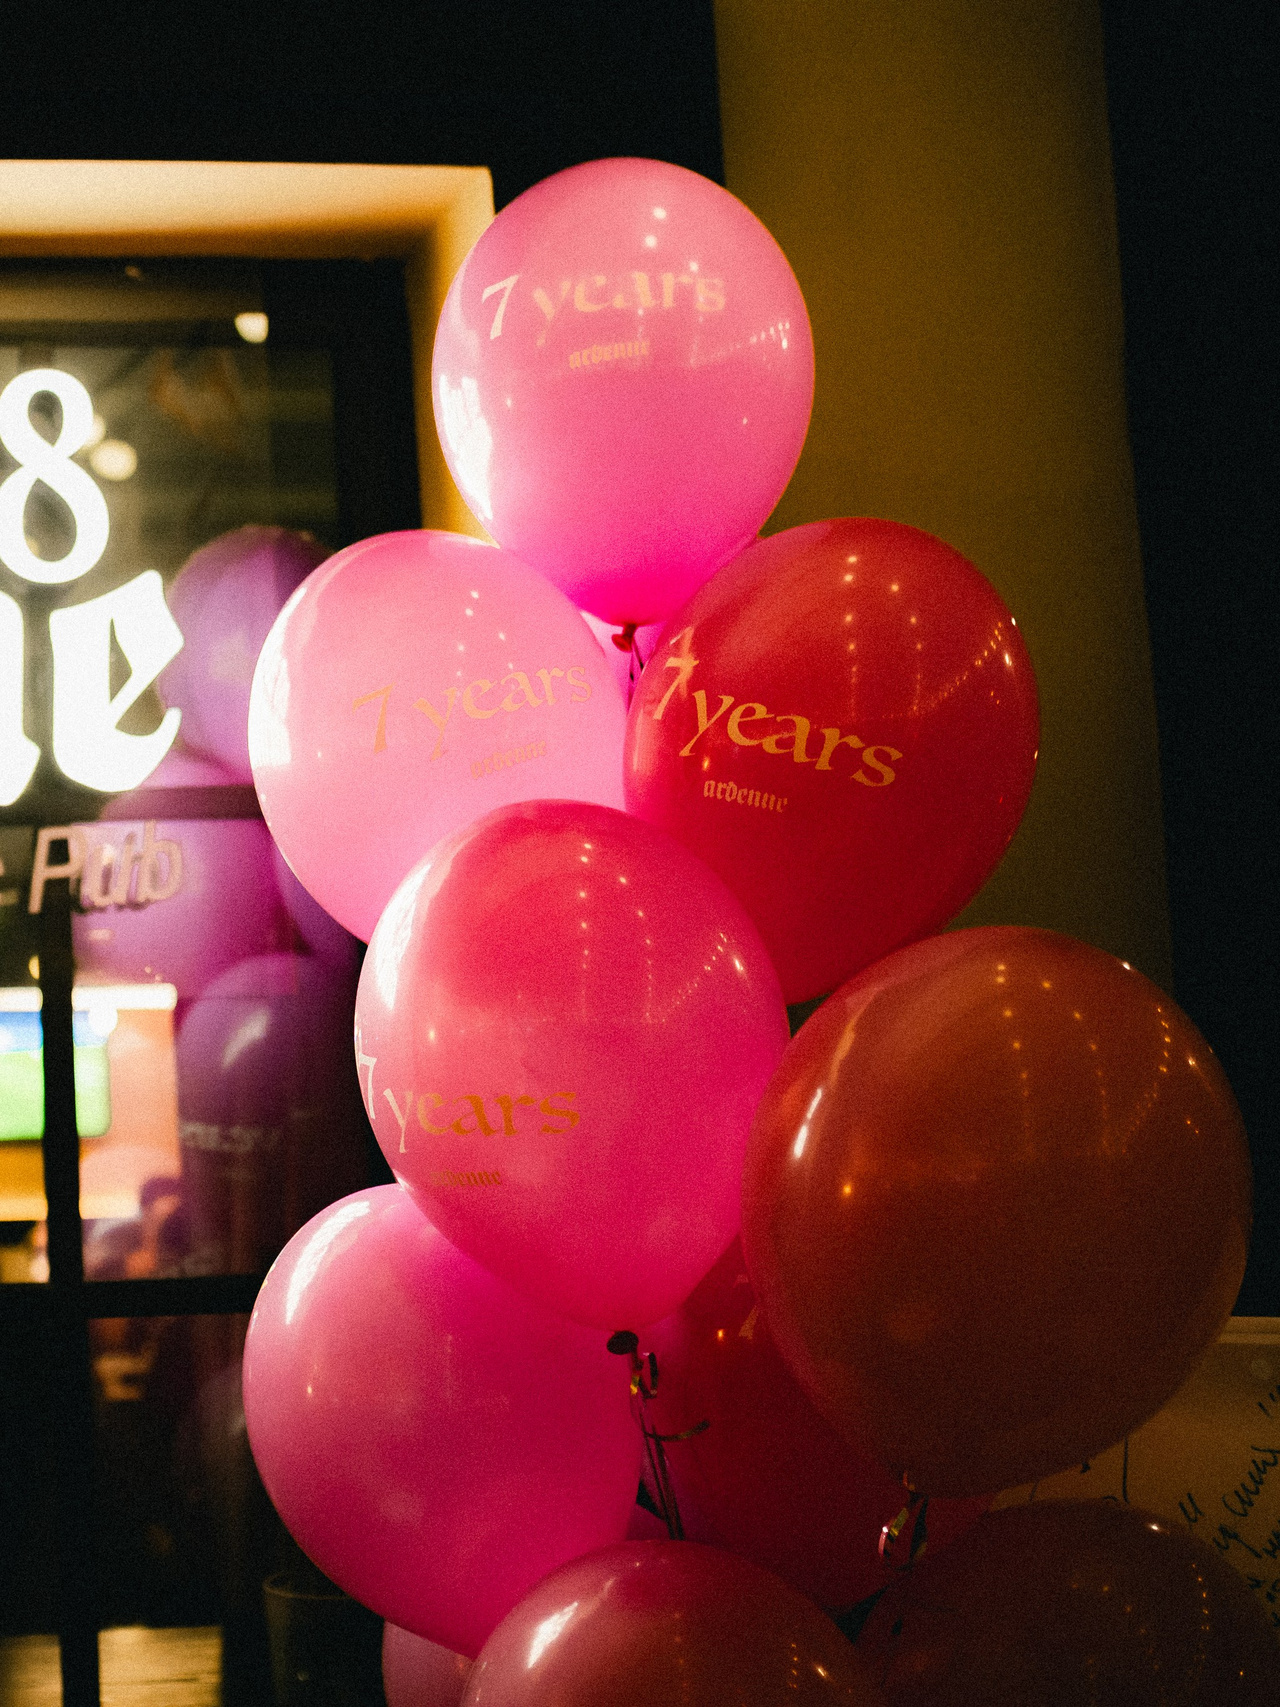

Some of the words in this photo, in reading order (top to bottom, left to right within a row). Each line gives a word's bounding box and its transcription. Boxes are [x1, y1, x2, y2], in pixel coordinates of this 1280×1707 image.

[481, 274, 520, 340] 7
[532, 270, 727, 347] years
[351, 681, 397, 756] 7
[411, 666, 593, 762] years
[652, 656, 700, 720] 7
[678, 689, 904, 787] years
[28, 819, 182, 915] Pub
[382, 1087, 581, 1153] years
